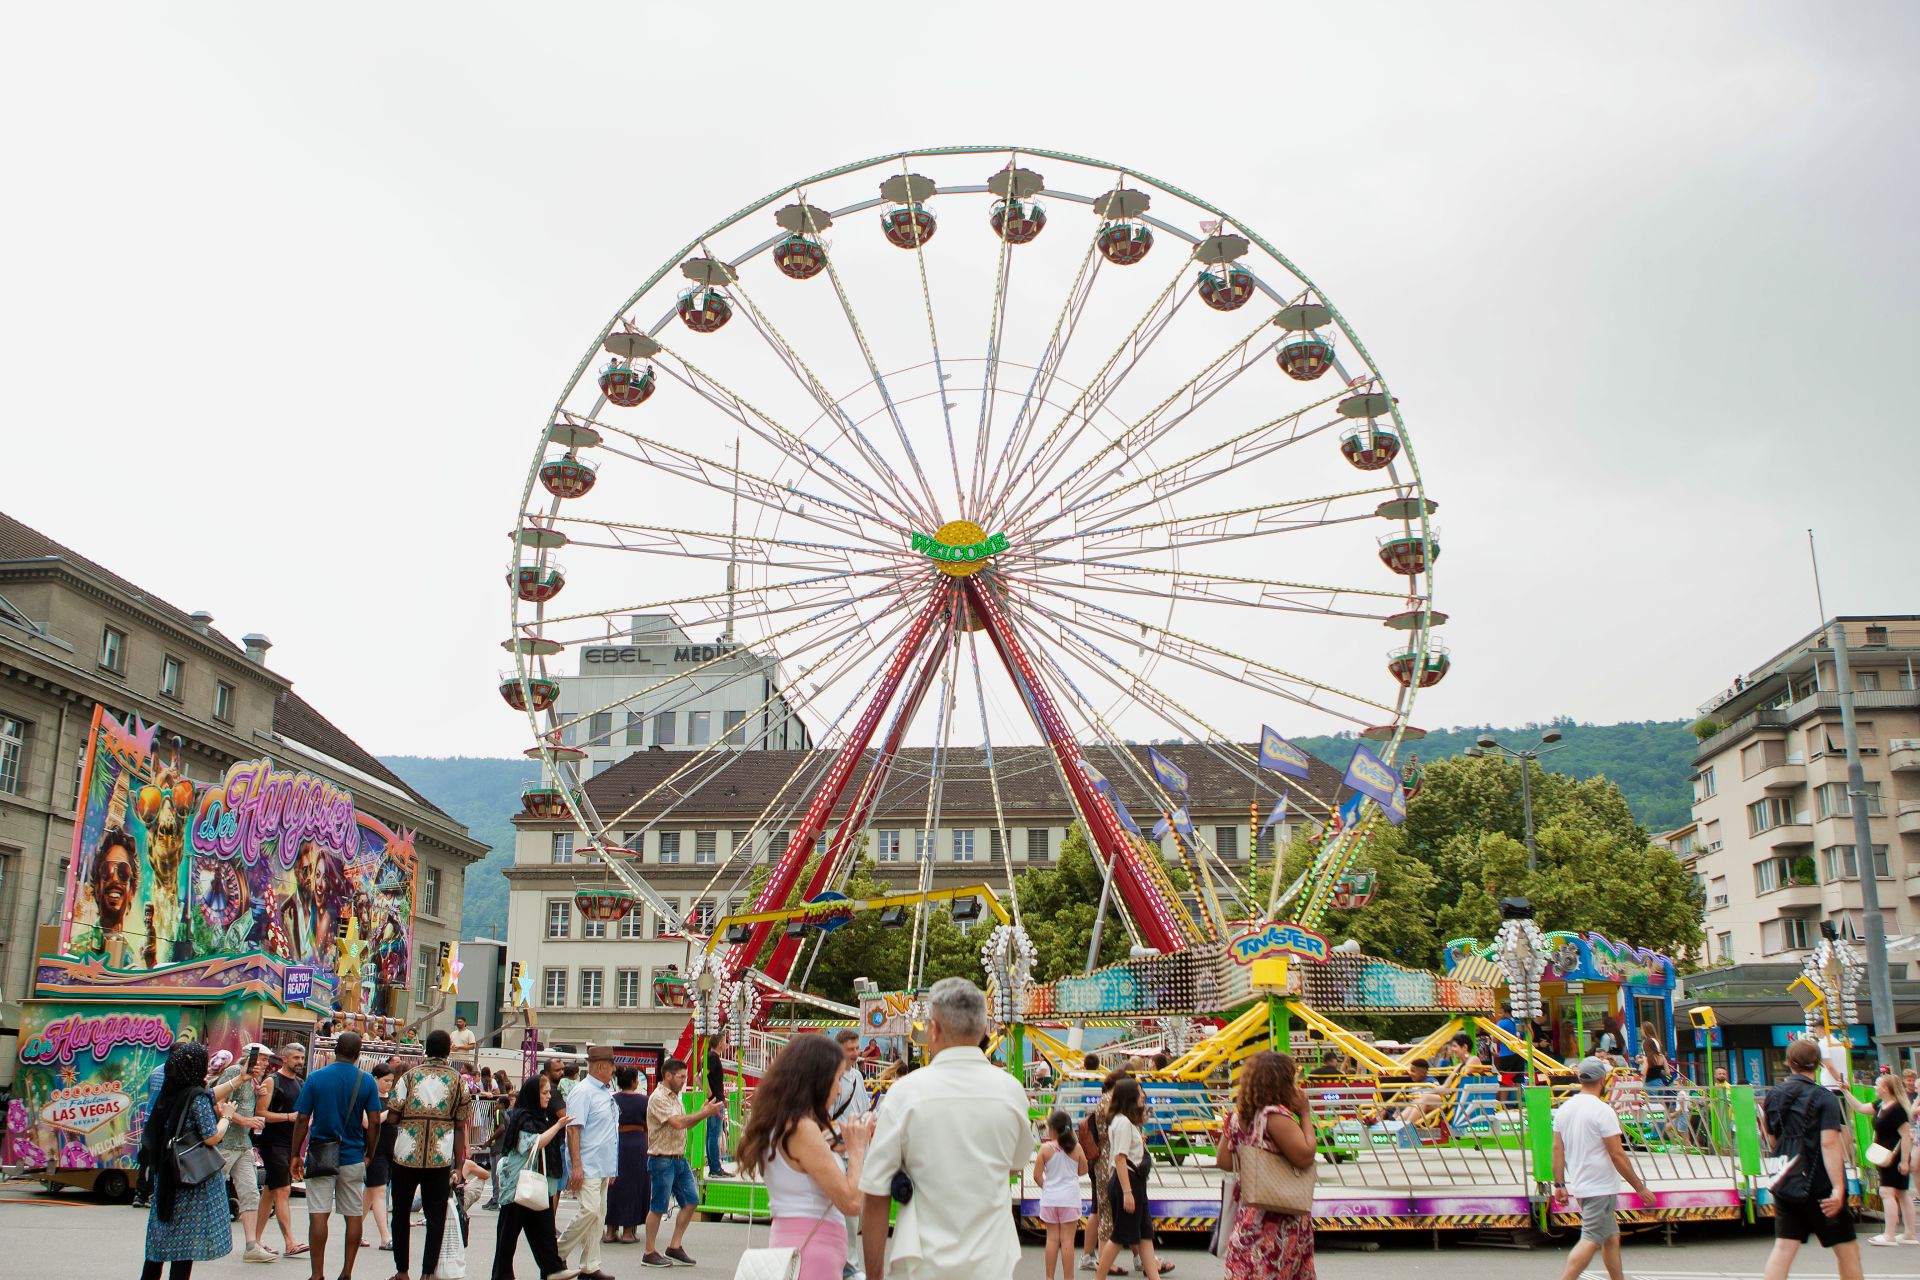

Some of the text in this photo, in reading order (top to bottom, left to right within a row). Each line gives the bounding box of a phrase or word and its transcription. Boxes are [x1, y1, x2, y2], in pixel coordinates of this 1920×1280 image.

[911, 531, 1010, 561] WELCOME
[585, 648, 651, 663] EBEL
[199, 764, 359, 862] Der Hangover
[1236, 927, 1323, 957] TWISTER
[287, 983, 310, 995] READY?
[288, 972, 310, 982] ARE YOU
[41, 1015, 170, 1061] Hangover
[53, 1101, 120, 1122] LAS VEGAS
